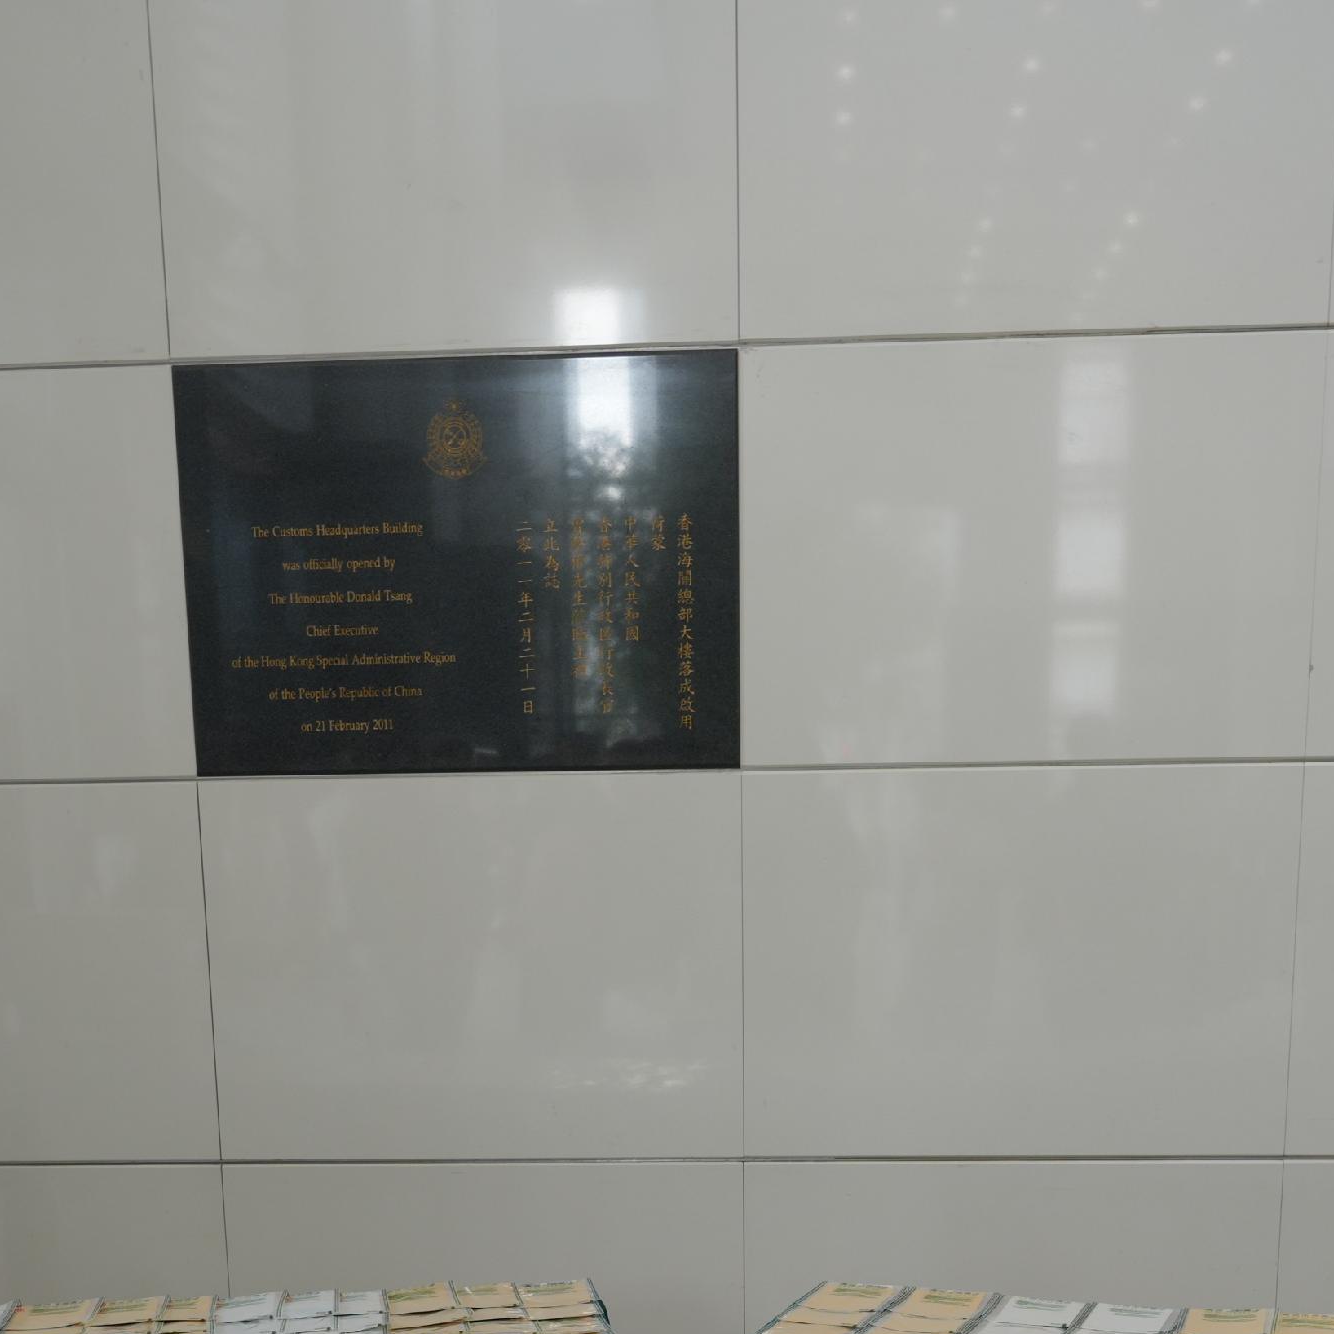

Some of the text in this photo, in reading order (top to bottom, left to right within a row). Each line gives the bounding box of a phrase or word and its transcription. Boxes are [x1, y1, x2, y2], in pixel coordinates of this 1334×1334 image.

[251, 522, 424, 539] The Customs Headquarters Building
[282, 556, 396, 572] was officially opened by
[624, 515, 641, 641] 中華人民共和國
[268, 589, 413, 605] The Honourable Donald Tsang
[306, 624, 379, 637] Chief Executive
[231, 651, 456, 670] of the Hong Kong Special Administrative Region
[269, 688, 279, 700] of
[281, 688, 296, 700] the
[339, 687, 379, 701] Republic
[381, 686, 392, 697] of
[394, 685, 423, 697] China
[301, 719, 394, 734] on 21 February 2011
